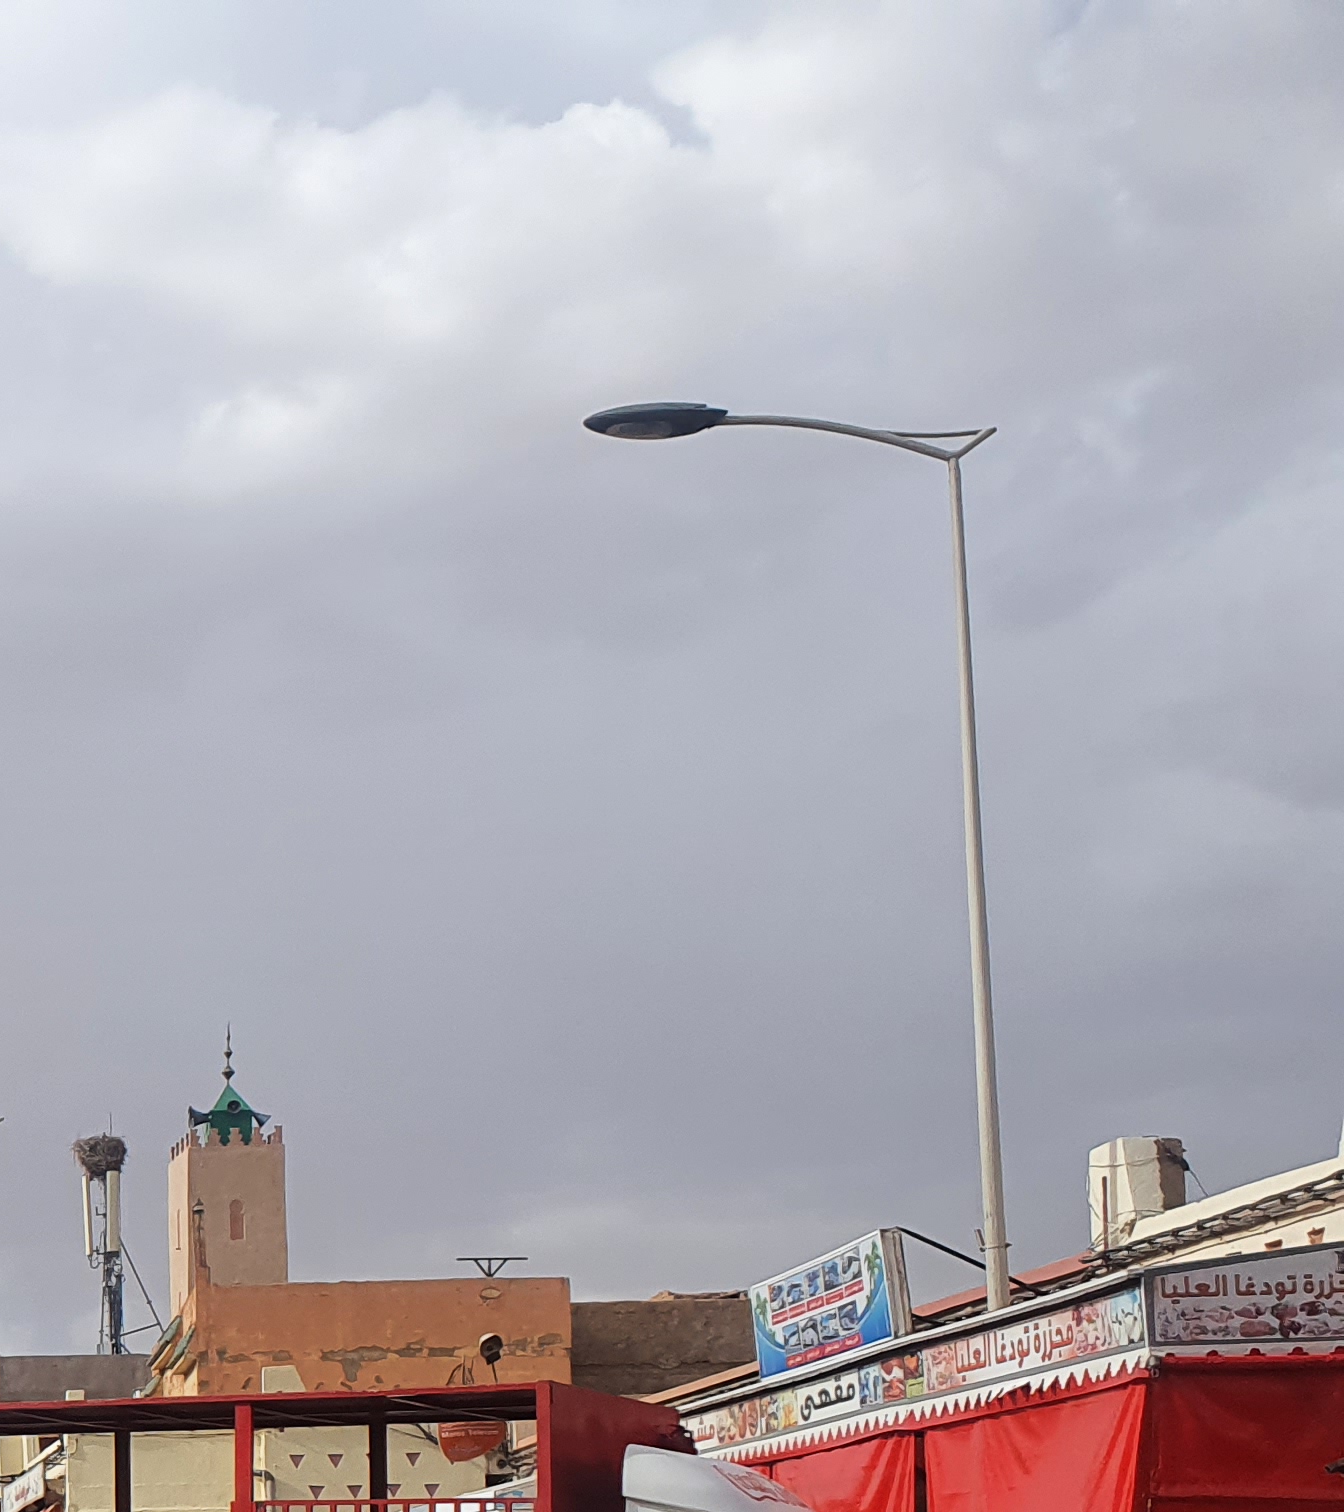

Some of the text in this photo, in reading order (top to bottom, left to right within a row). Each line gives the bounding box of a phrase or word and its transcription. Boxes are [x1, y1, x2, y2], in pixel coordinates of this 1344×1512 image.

[1161, 1273, 1344, 1305] جزرة تودغا العليا
[954, 1317, 1074, 1383] مجزرة تودغا العليا
[799, 1377, 857, 1422] مقهى
